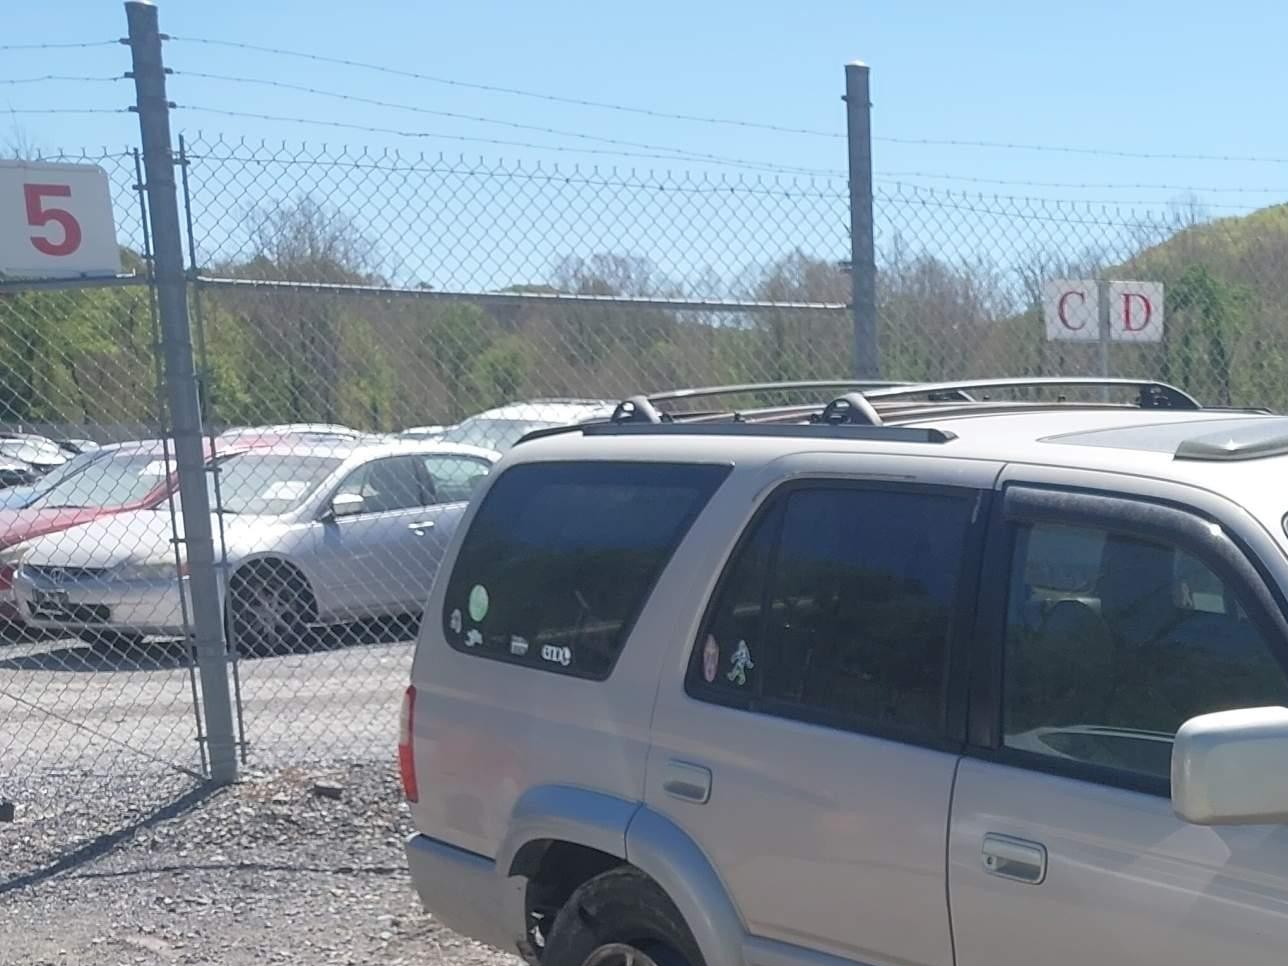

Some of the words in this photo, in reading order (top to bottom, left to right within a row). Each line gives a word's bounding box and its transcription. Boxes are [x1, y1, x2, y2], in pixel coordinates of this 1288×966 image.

[23, 183, 82, 257] 5
[1058, 290, 1086, 331] C
[1121, 292, 1152, 331] D
